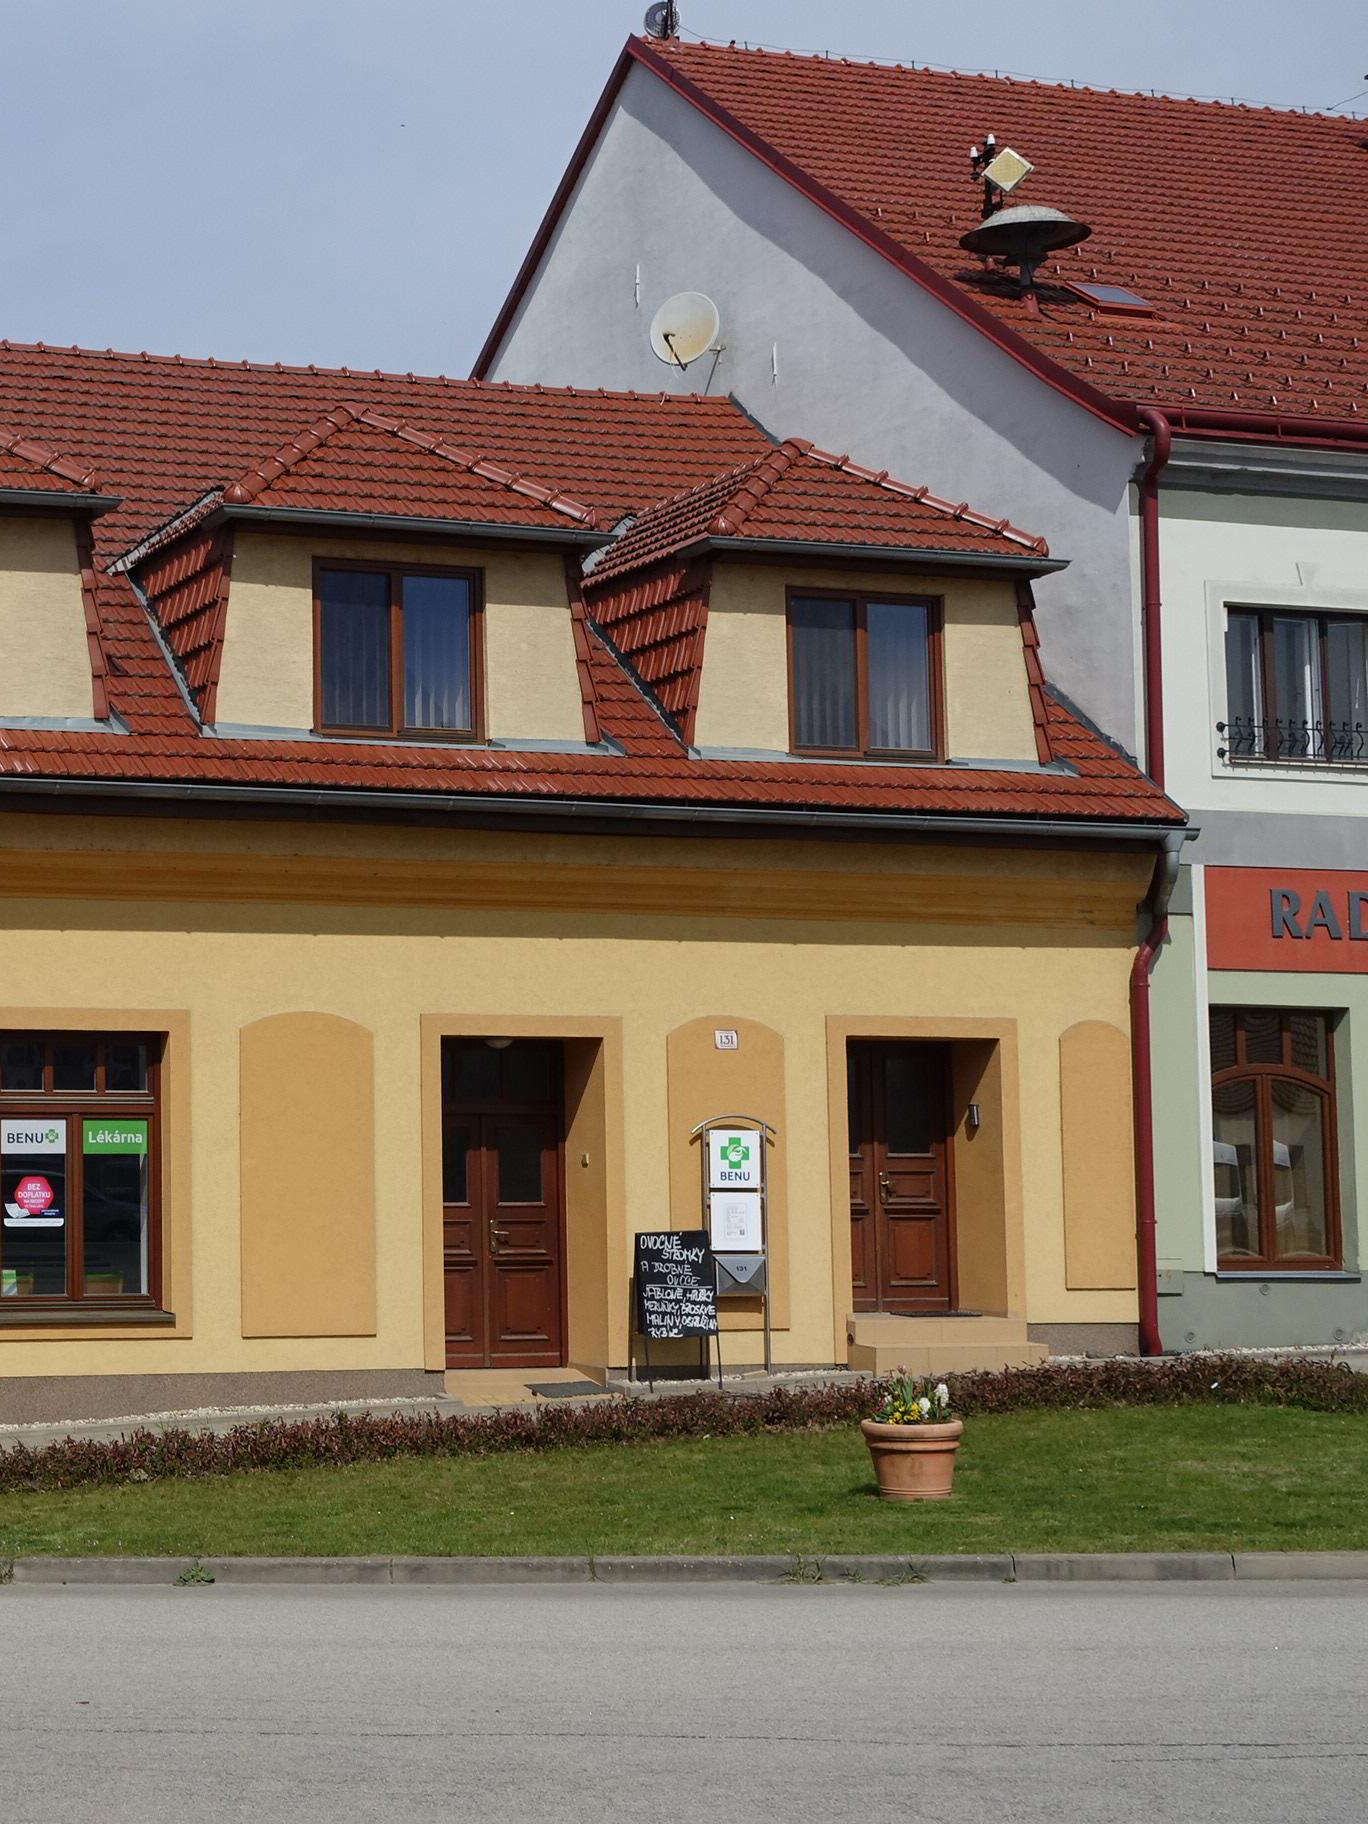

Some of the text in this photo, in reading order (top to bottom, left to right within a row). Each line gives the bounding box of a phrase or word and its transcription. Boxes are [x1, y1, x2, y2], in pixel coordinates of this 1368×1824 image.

[720, 1035, 734, 1045] 131
[7, 1132, 44, 1144] BENU
[88, 1130, 143, 1144] Lékárna
[720, 1171, 750, 1181] BENU
[27, 1183, 41, 1191] BEZ
[17, 1191, 51, 1199] DOPLATKU
[640, 1232, 683, 1249] OVOCNÉ
[661, 1247, 705, 1264] STROMKY
[640, 1260, 693, 1275] A DROBNÉ
[666, 1275, 702, 1286] OVOCE
